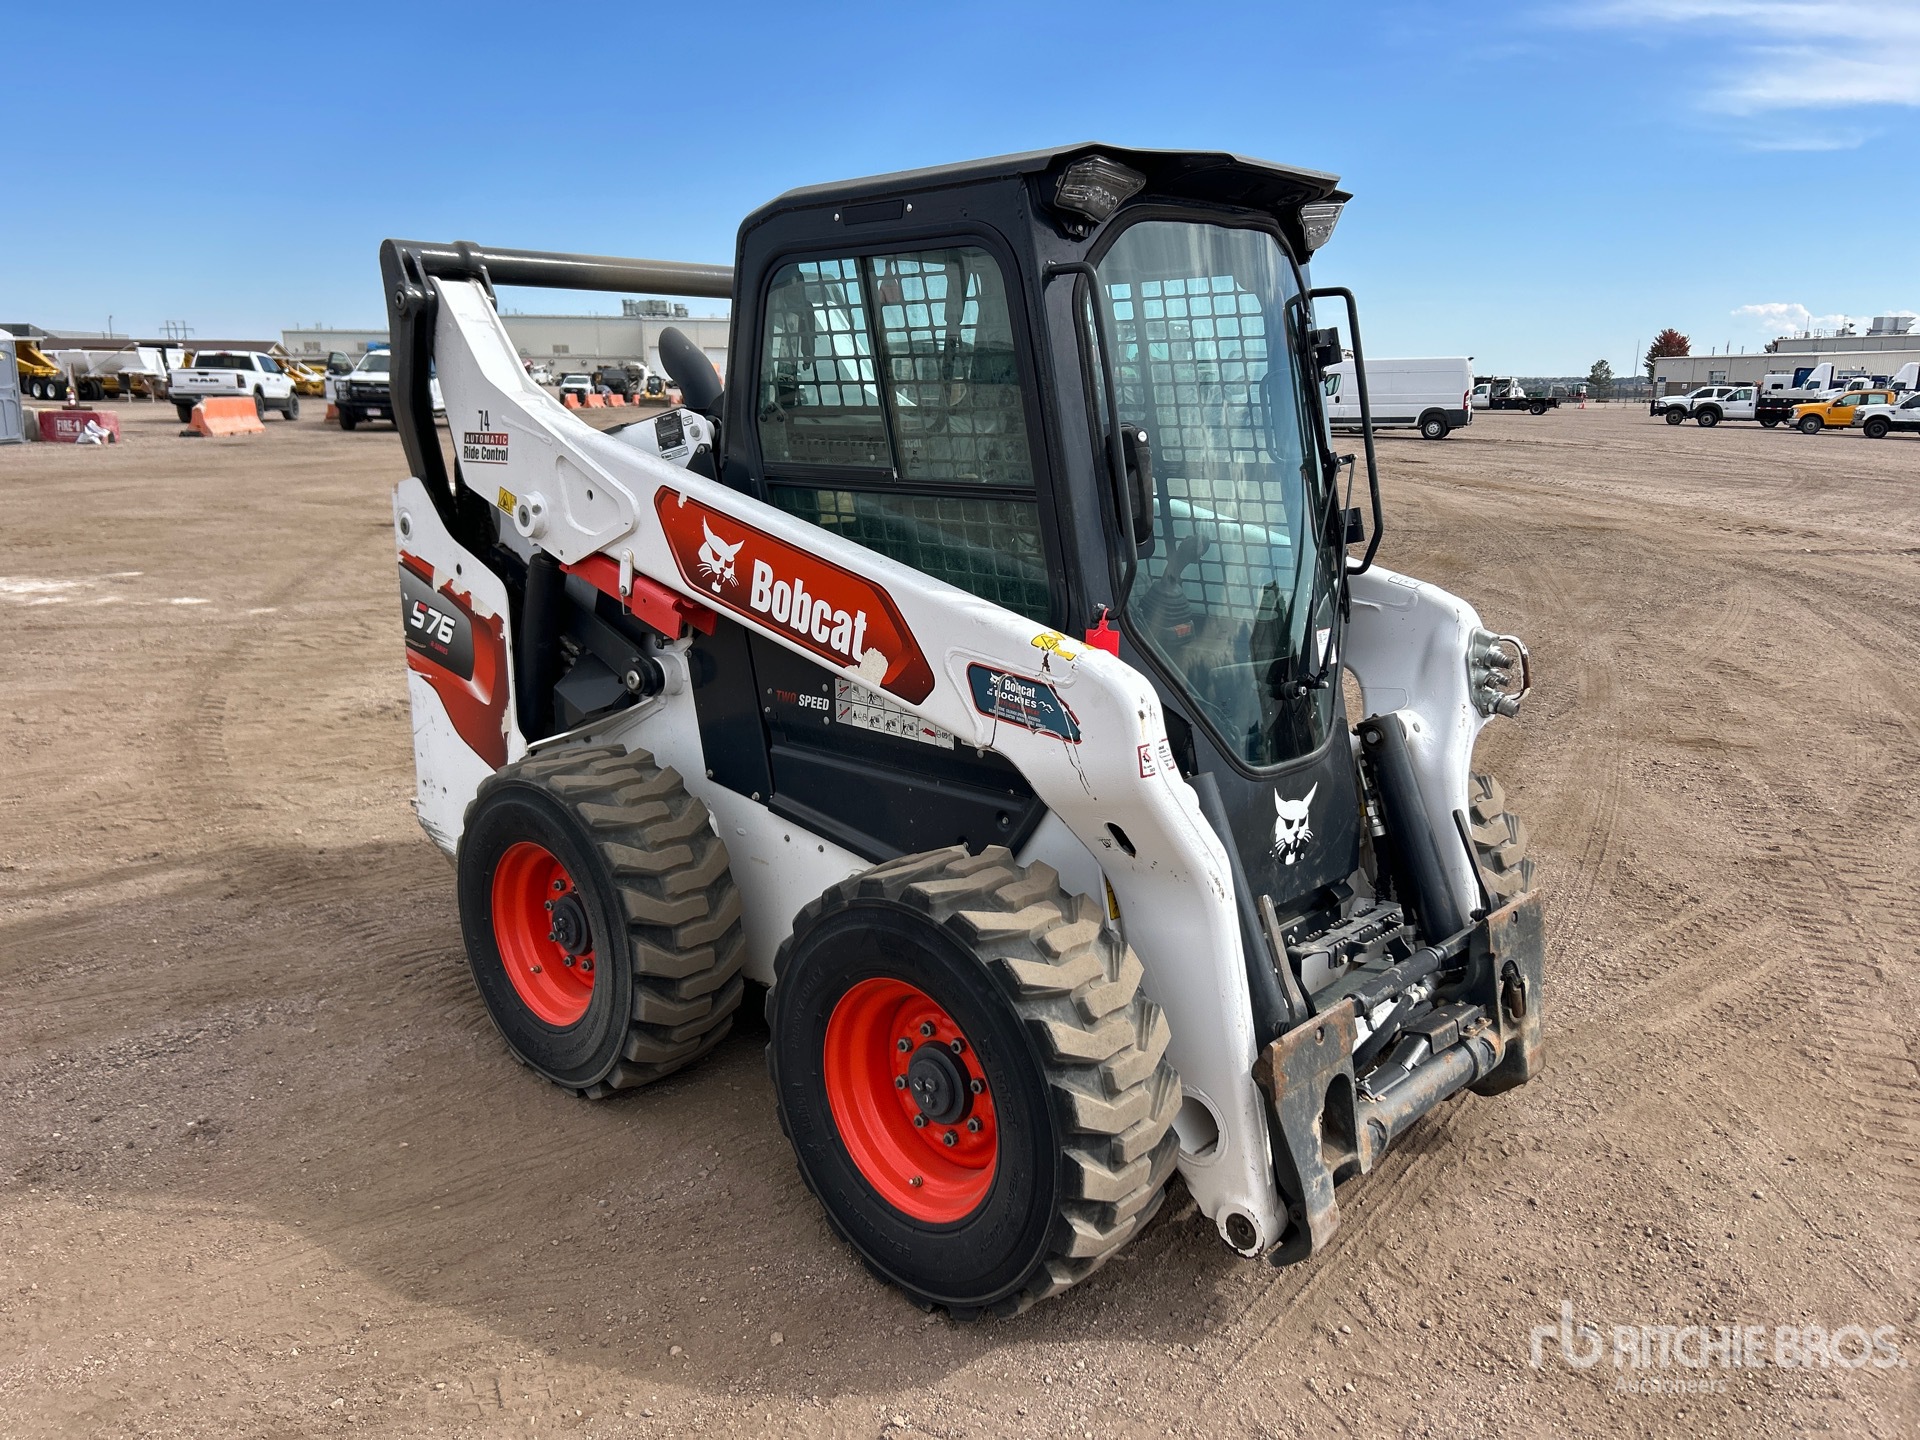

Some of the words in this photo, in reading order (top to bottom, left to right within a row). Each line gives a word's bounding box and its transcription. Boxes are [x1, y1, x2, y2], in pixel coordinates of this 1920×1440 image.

[478, 410, 490, 431] 74
[465, 434, 507, 444] AUTOMATIC
[463, 446, 480, 460] Ride
[481, 446, 509, 461] Control
[750, 558, 867, 663] Bobcat
[411, 600, 456, 644] S76
[776, 690, 797, 704] TWO
[798, 694, 830, 711] SPEED
